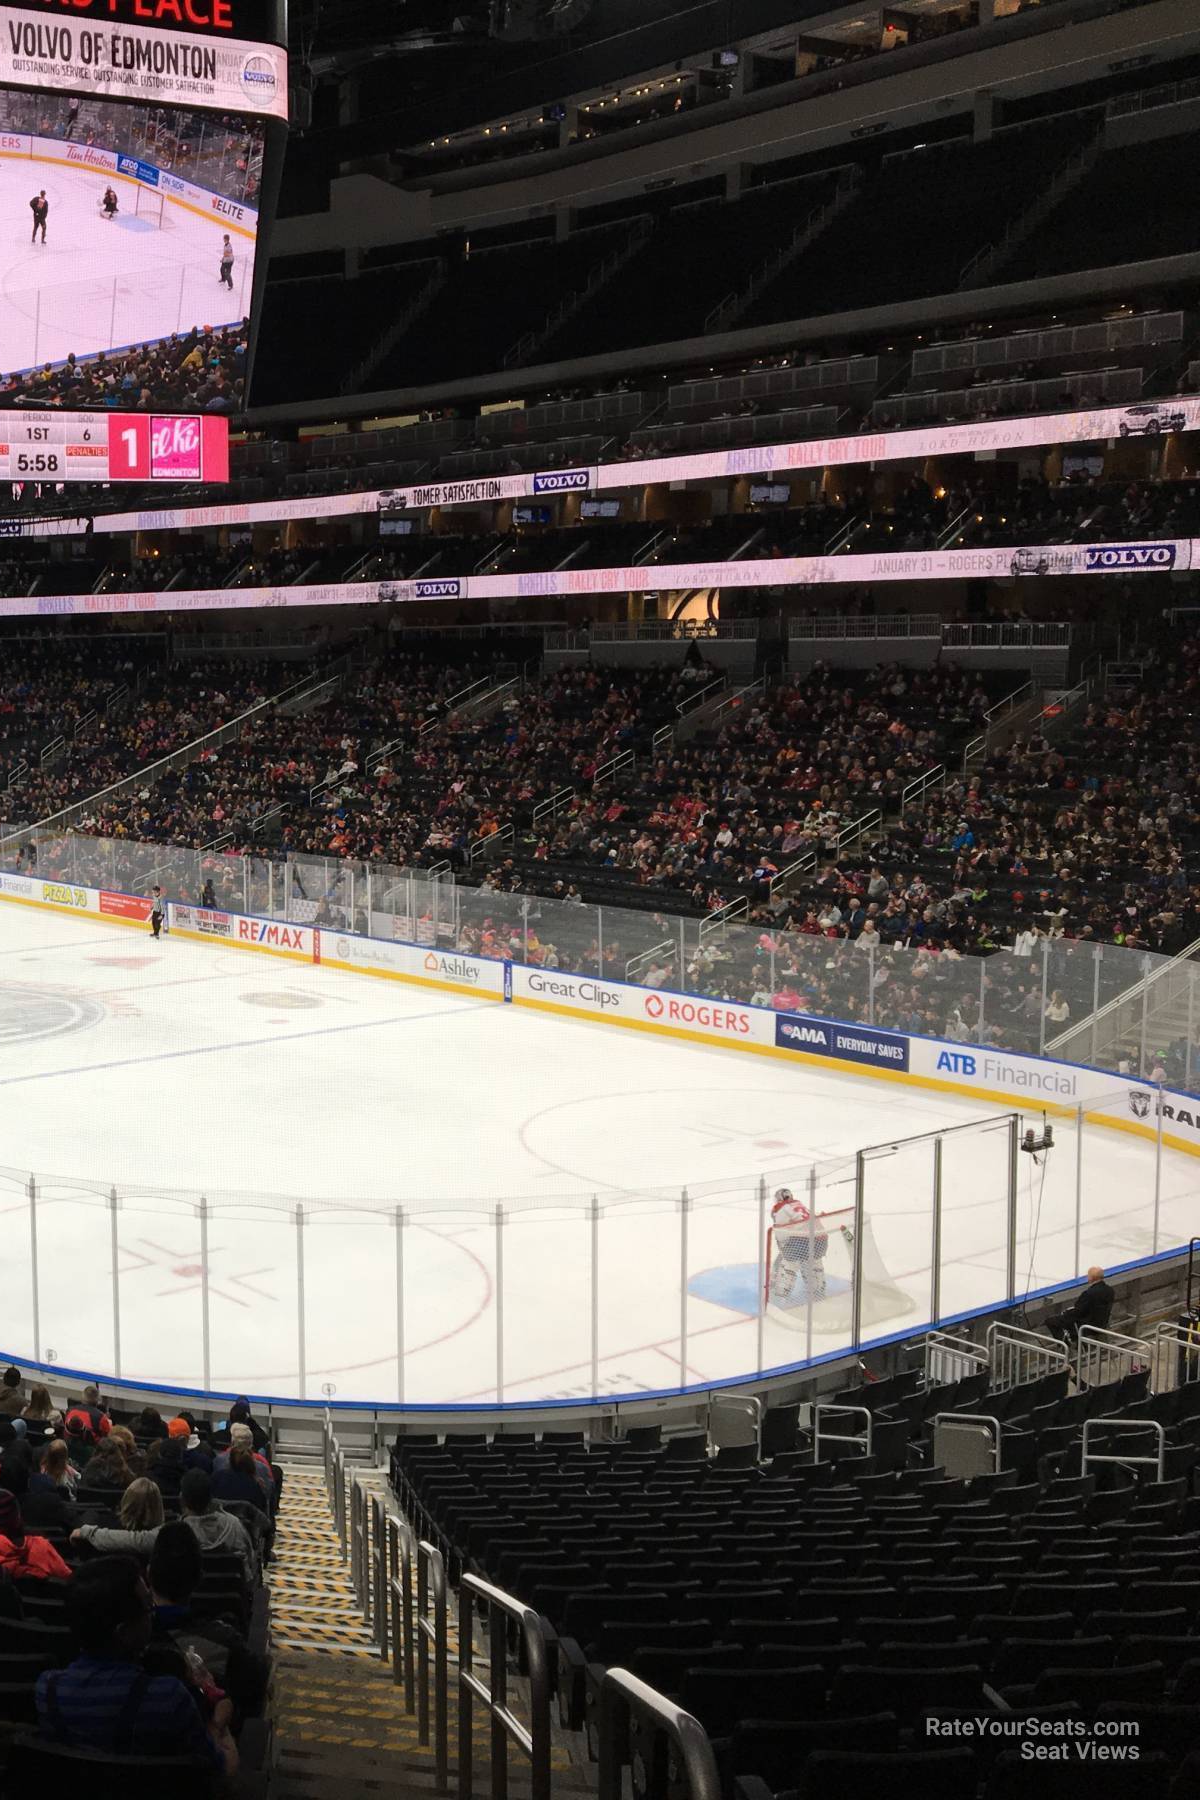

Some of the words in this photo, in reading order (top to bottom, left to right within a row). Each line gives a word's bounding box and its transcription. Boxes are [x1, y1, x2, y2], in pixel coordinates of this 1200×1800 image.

[8, 20, 72, 62] VOLVO
[80, 31, 103, 65] OF
[111, 34, 217, 80] EDMONTON
[12, 58, 60, 77] OUTSTANDING
[93, 69, 139, 85] OUTSTANDING
[140, 74, 174, 90] CUSTOMER
[66, 144, 82, 161] Tim
[216, 198, 244, 220] ELITE
[26, 428, 50, 441] 1ST
[83, 429, 91, 441] 6
[66, 447, 108, 456] PENALTIES
[121, 428, 138, 468] 1
[788, 443, 825, 465] RALLY
[828, 439, 850, 461] CRY
[853, 437, 887, 459] TOUR
[17, 454, 58, 471] 5:58
[152, 467, 199, 477] EDMONTON
[536, 473, 587, 489] VOLVO
[413, 488, 440, 505] TOMER
[443, 481, 504, 503] SATISFACTION.
[185, 509, 208, 524] RALLY
[211, 507, 226, 522] CRY
[229, 505, 250, 522] TOUR
[870, 556, 918, 574] JANUARY
[920, 555, 933, 572] 31
[948, 554, 993, 571] ROGERS
[1086, 548, 1172, 566] VOLVO
[415, 581, 459, 596] VOLVO
[569, 570, 598, 590] RALLY
[601, 569, 619, 589] CRY
[623, 568, 650, 588] TOUR
[85, 595, 112, 610] RALLY
[113, 595, 130, 609] CRY
[134, 594, 157, 608] TOUR
[42, 882, 73, 904] PIZZA
[73, 890, 87, 908] 73
[239, 919, 303, 949] RE/MAX
[438, 957, 481, 983] Ashley
[528, 974, 575, 998] Great
[578, 982, 620, 1009] Clips
[669, 1000, 750, 1034] ROGERS
[790, 1026, 827, 1045] AMA
[836, 1035, 877, 1055] EVERYDAY
[877, 1043, 904, 1060] SAVES
[936, 1050, 977, 1076] ATB
[983, 1058, 1077, 1096] Financial
[1155, 1103, 1200, 1129] RA
